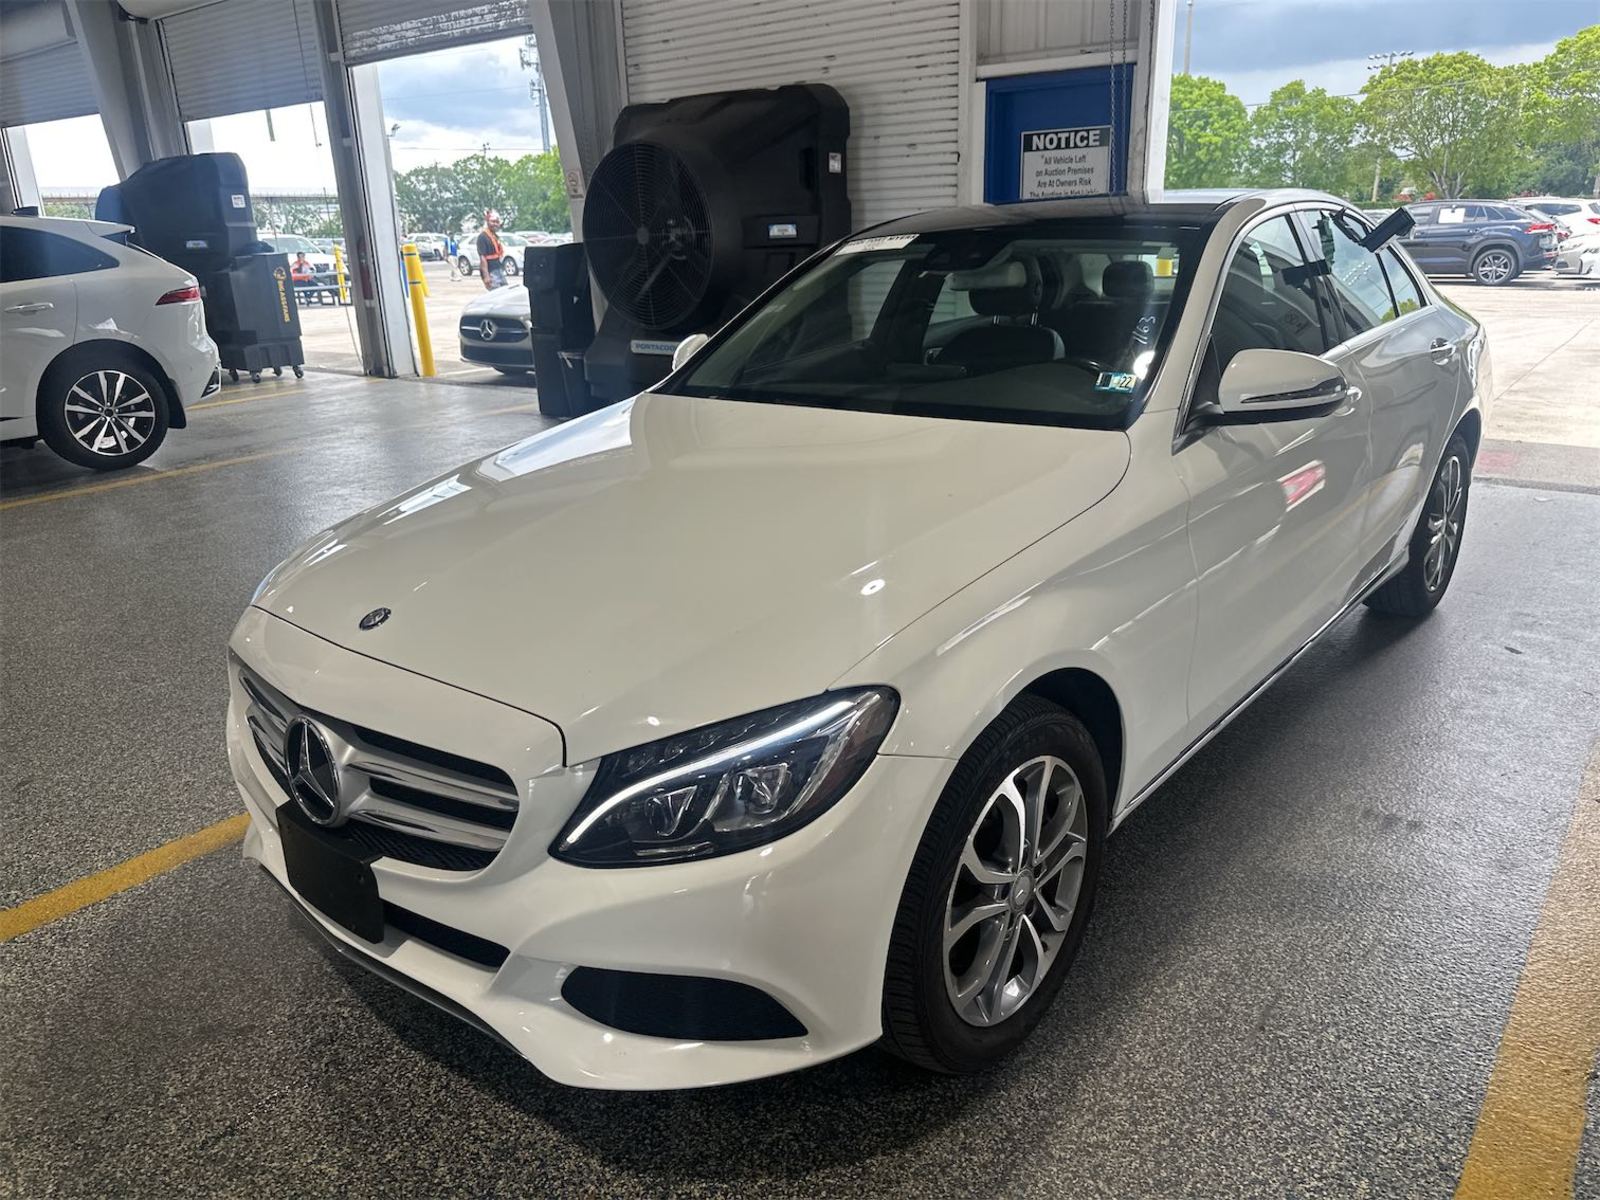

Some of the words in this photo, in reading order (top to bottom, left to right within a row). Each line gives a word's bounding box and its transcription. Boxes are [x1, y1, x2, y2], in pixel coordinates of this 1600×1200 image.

[1032, 130, 1100, 150] NOTICE
[1053, 155, 1073, 165] Vehicle
[1074, 154, 1087, 164] Left
[1035, 169, 1043, 177] on
[1044, 168, 1067, 177] Auction
[1067, 167, 1095, 176] Premises
[1037, 180, 1047, 188] Are
[1047, 179, 1055, 188] At
[1055, 179, 1078, 188] Owners
[1079, 178, 1092, 186] Risk
[635, 343, 677, 351] PORTACOO
[1119, 376, 1132, 387] 22
